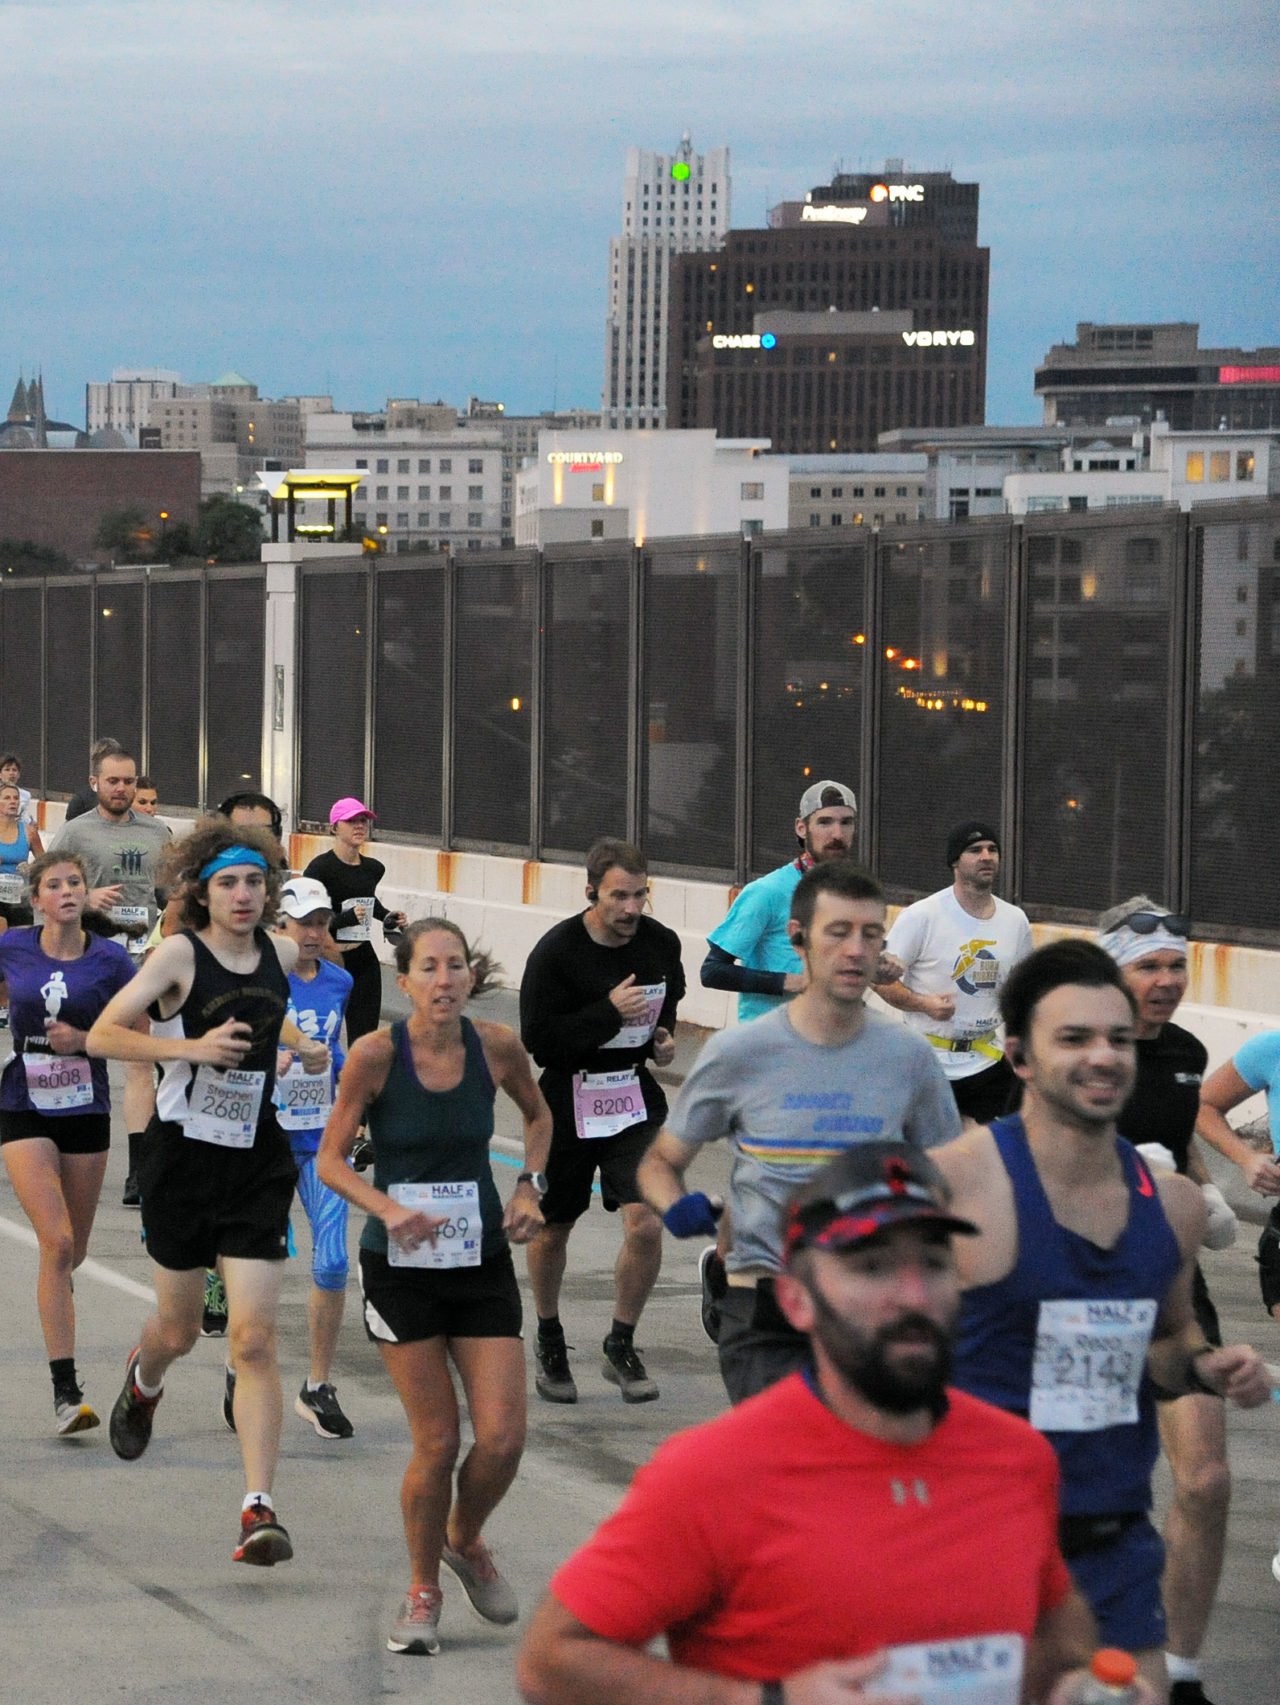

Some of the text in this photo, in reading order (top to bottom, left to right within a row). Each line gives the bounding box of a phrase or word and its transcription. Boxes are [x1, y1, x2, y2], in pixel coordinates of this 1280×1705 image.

[889, 185, 924, 201] PNC
[712, 334, 761, 348] CHASE
[902, 330, 974, 346] VORYS
[547, 452, 623, 463] COURTYARD
[38, 1068, 81, 1089] 8008
[227, 1071, 254, 1082] HALF
[606, 1074, 630, 1083] RELAY
[206, 1084, 254, 1100] Stephen
[287, 1089, 326, 1107] 2992
[201, 1095, 253, 1122] 2680
[593, 1096, 635, 1116] 8200
[432, 1184, 464, 1195] HALF
